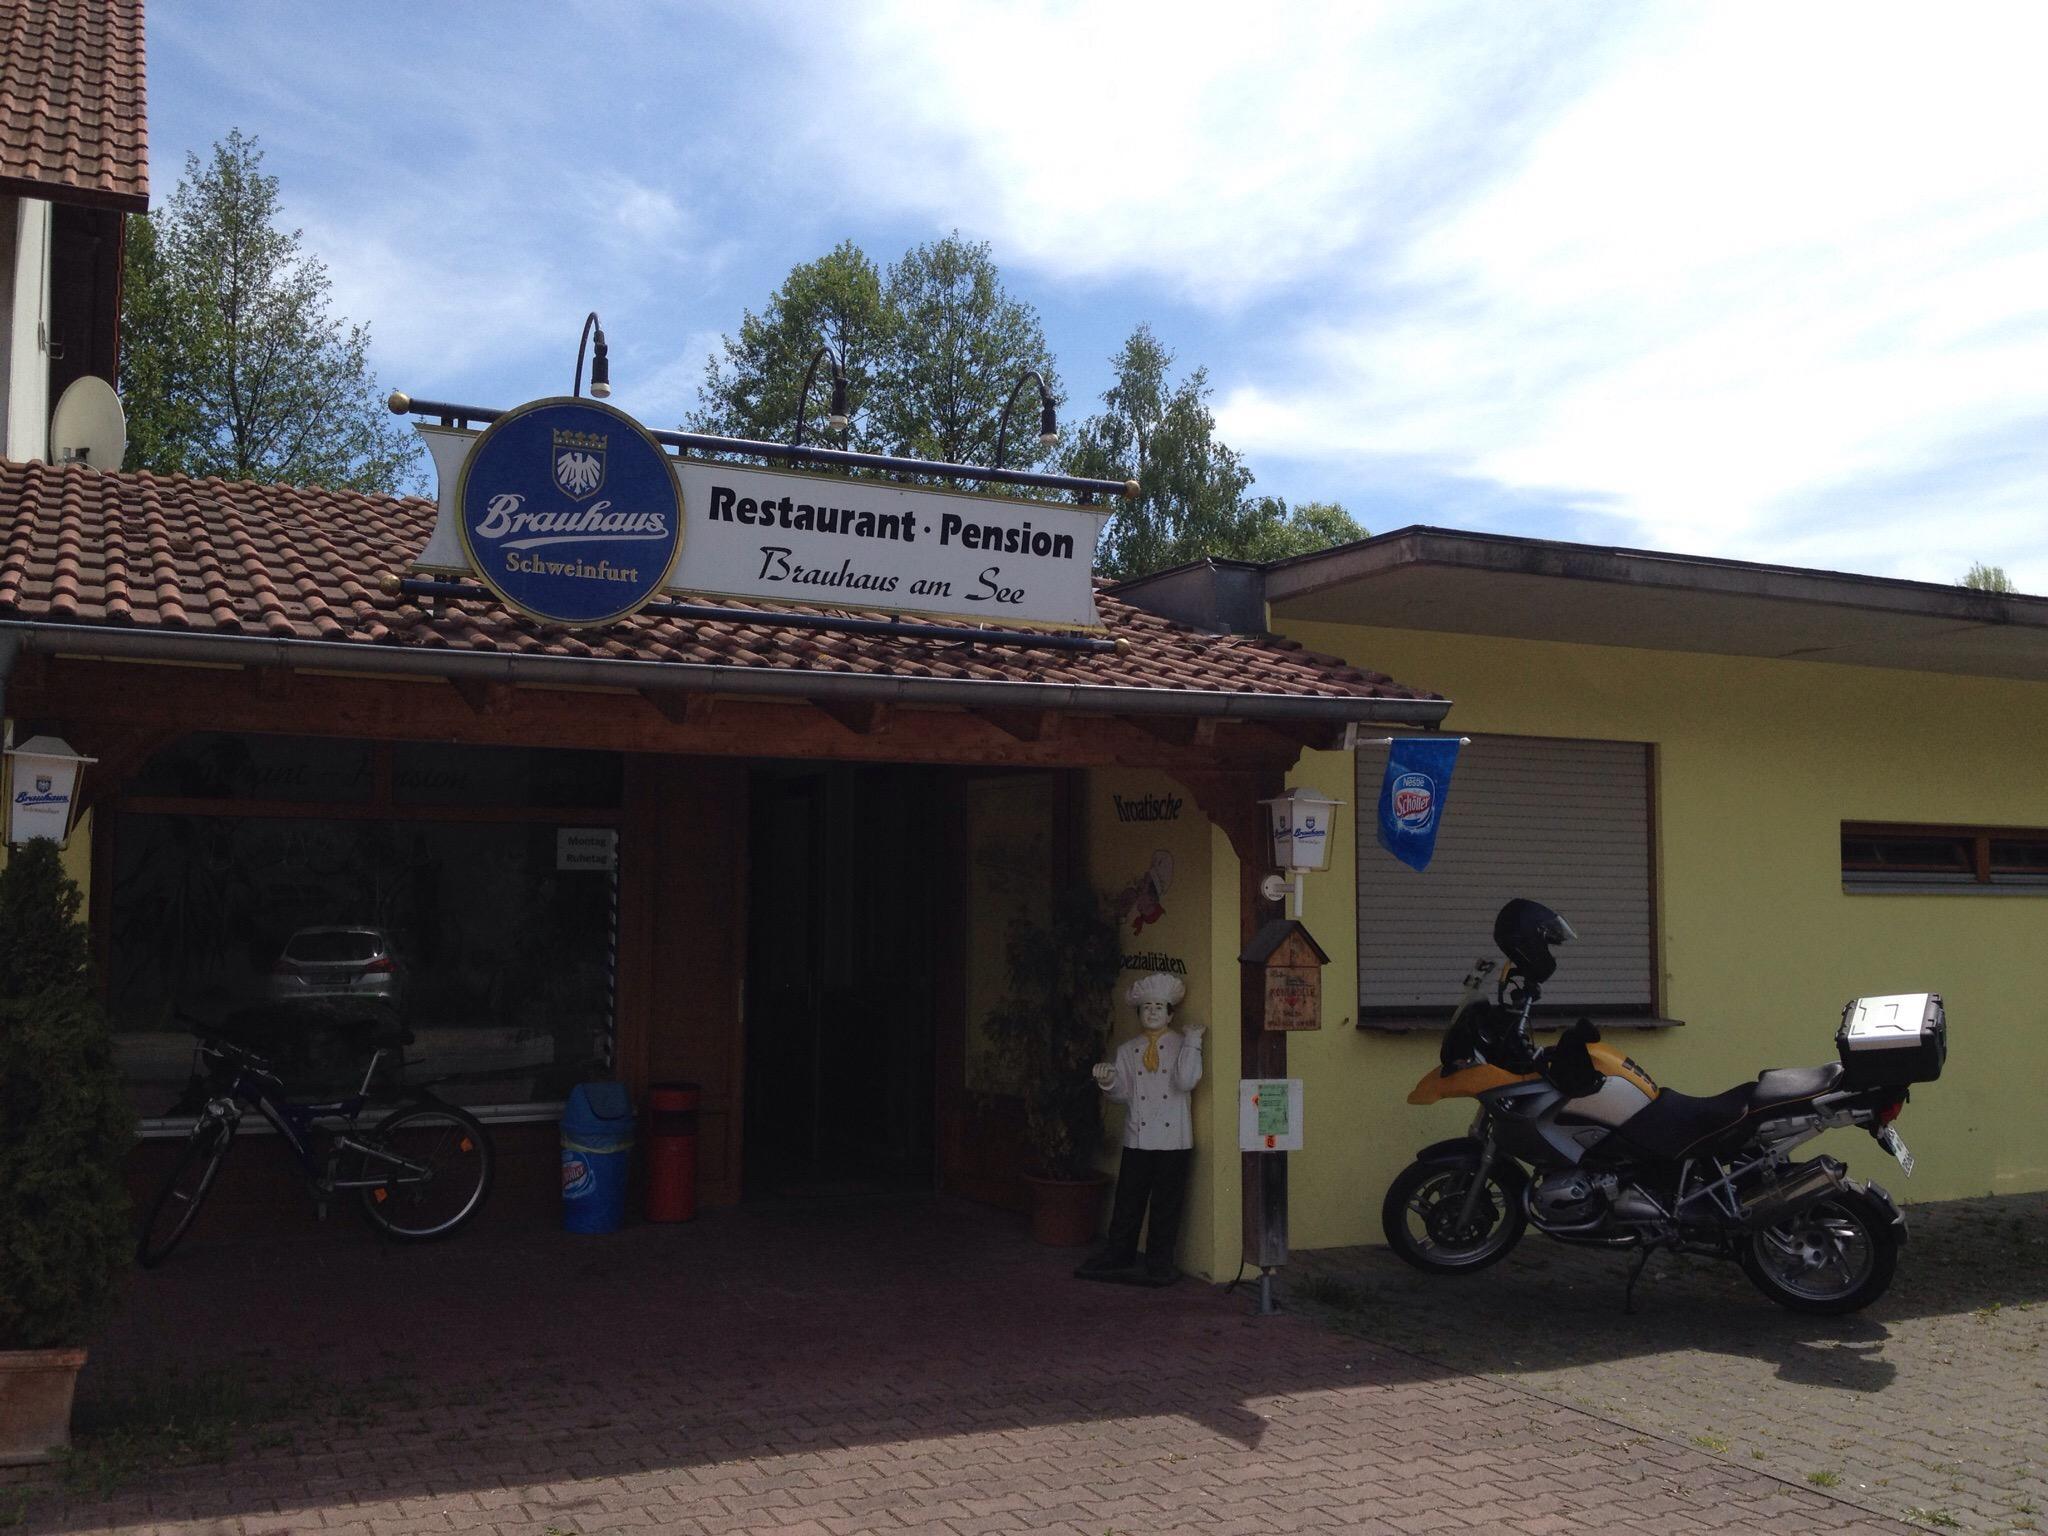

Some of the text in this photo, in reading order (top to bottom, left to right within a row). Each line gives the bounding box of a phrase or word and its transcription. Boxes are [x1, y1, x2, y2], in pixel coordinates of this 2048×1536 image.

[475, 494, 669, 546] Brauhaus
[709, 486, 1074, 559] Restaurant Pension
[505, 552, 639, 583] Schweinfurt
[758, 546, 1025, 604] Brauhaus am See
[1113, 792, 1183, 822] Kroatische
[567, 836, 607, 848] Montag
